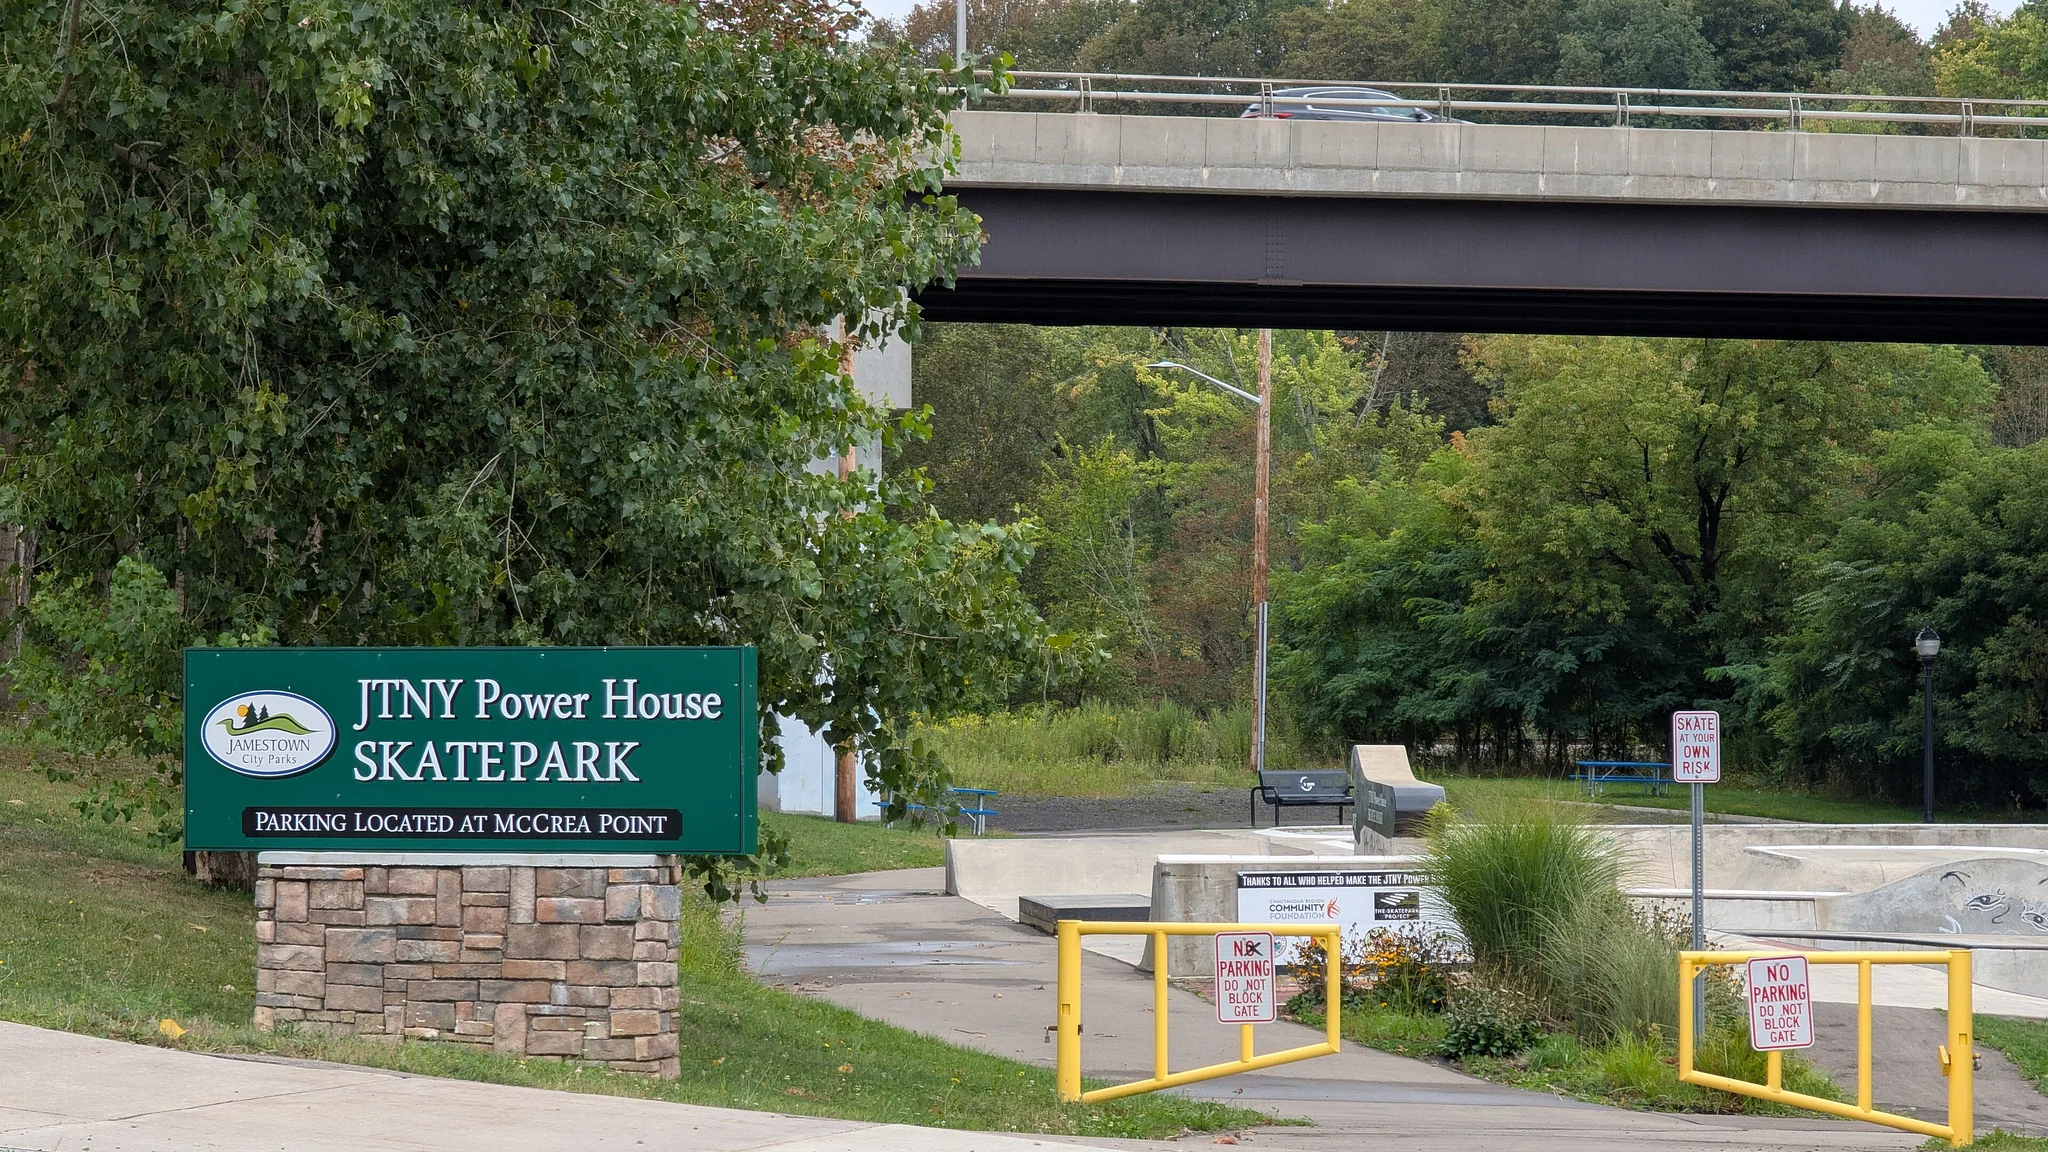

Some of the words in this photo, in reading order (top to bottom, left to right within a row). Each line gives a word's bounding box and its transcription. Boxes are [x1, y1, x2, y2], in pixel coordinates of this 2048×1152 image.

[353, 679, 464, 731] JTNY
[475, 679, 590, 719] Power
[600, 679, 722, 719] House
[1678, 717, 1715, 730] SKATE
[1680, 734, 1689, 742] AT
[1693, 734, 1715, 742] YOUR
[226, 739, 310, 755] JAMESTOWN
[1684, 745, 1710, 758] OWN
[242, 754, 264, 767] City
[268, 754, 297, 764] Parks
[353, 740, 641, 781] SKATEPARK
[1683, 761, 1710, 774] RISK
[255, 812, 347, 832] PARKING
[354, 812, 454, 832] LOCATED
[459, 815, 488, 833] AT
[598, 814, 668, 834] POINT
[1242, 876, 1271, 887] THANKS
[1272, 876, 1281, 886] TO
[1283, 876, 1297, 886] ALL
[1298, 876, 1316, 886] WHO
[1317, 875, 1344, 886] HELPED
[1346, 875, 1367, 885] MAKE
[1368, 875, 1382, 885] THE
[1269, 904, 1325, 912] COMMUNITY
[1270, 912, 1325, 920] FOUNDATION
[1220, 960, 1270, 977] PARKING
[1767, 964, 1790, 982] NO
[1224, 980, 1239, 991] DO
[1246, 979, 1266, 991] NOT
[1229, 992, 1263, 1004] BLOCK
[1754, 984, 1806, 1003] PARKING
[1234, 1005, 1259, 1017] GATE
[1760, 1005, 1774, 1017] DO
[1782, 1003, 1803, 1016] NOT
[1764, 1016, 1800, 1030] BLOCK
[1770, 1030, 1797, 1042] GATE
